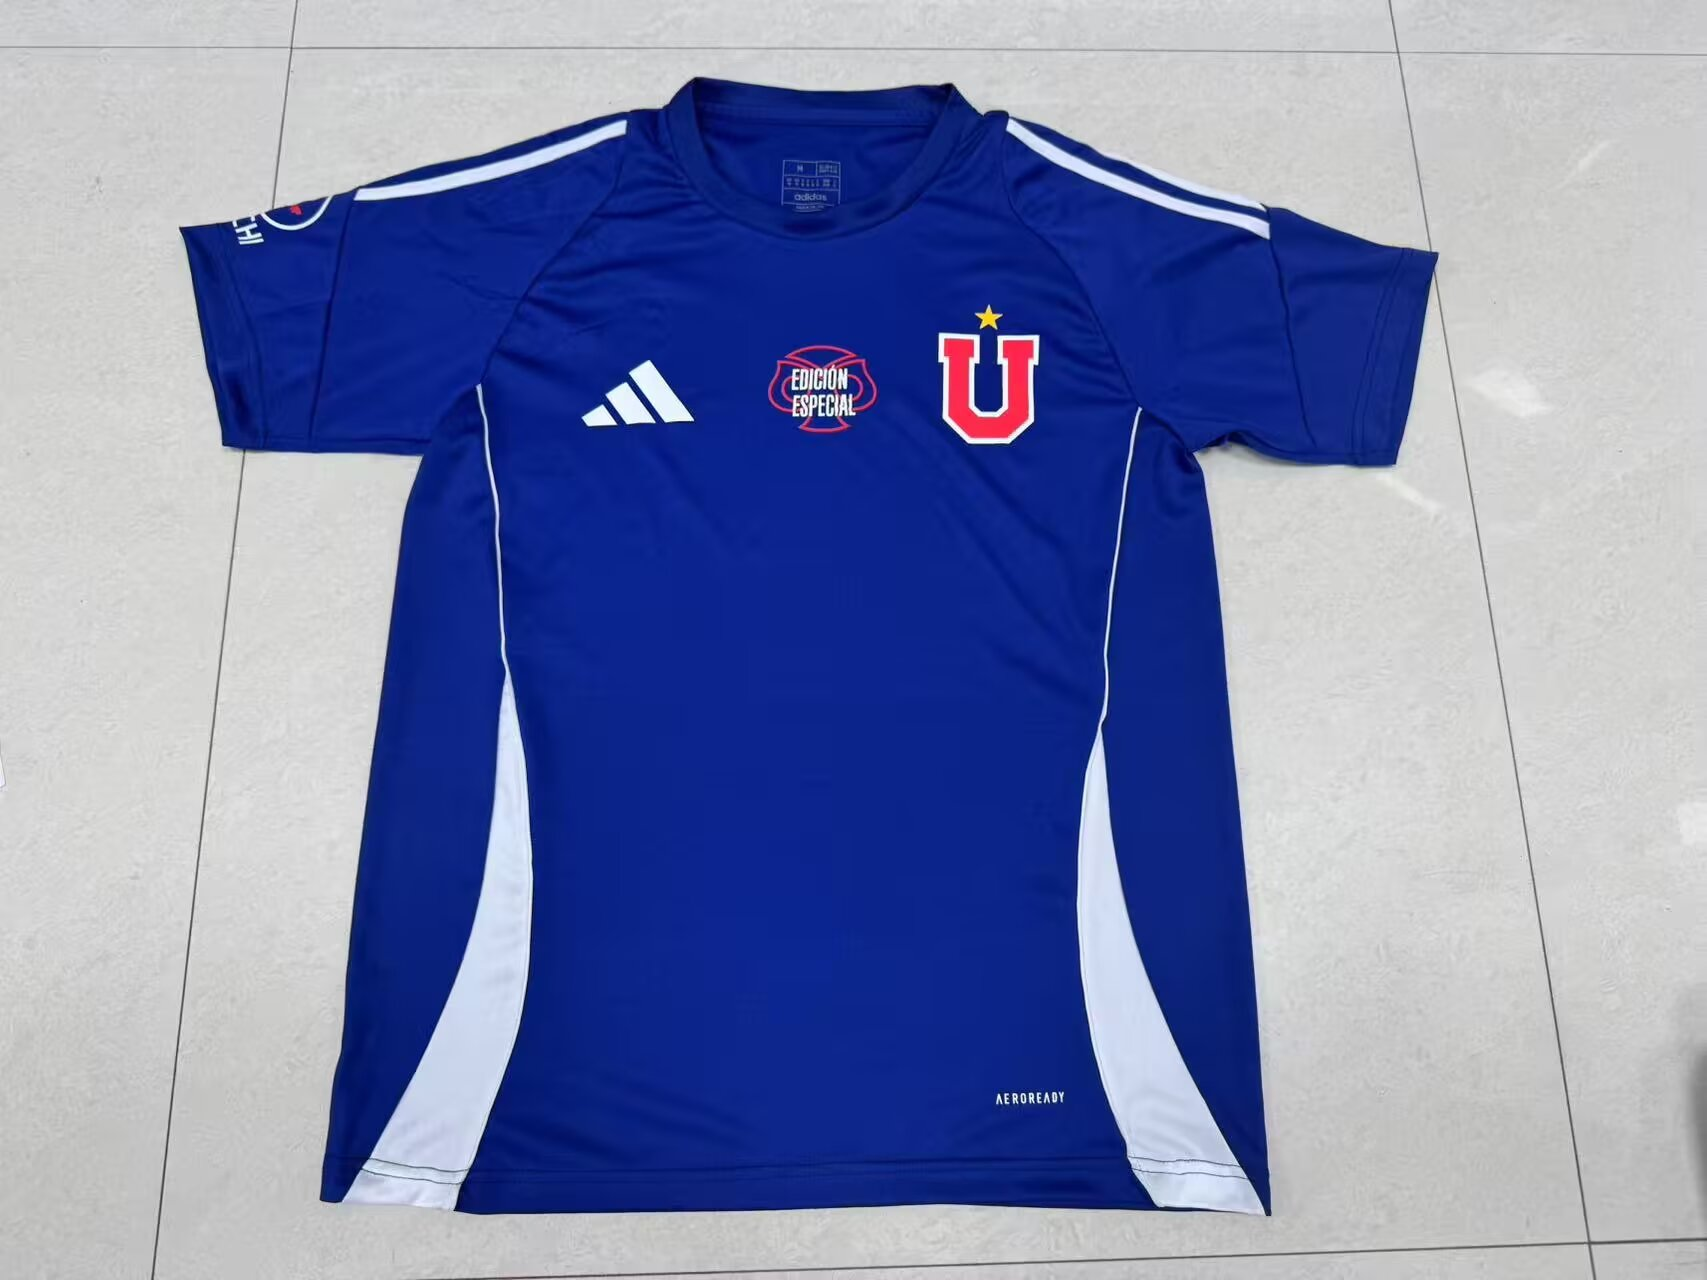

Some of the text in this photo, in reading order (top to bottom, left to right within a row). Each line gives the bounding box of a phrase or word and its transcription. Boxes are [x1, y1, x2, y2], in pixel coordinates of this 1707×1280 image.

[794, 193, 828, 202] adidas
[791, 364, 848, 391] EDICIÓN
[938, 332, 1040, 445] U
[792, 394, 857, 417] ESPECIAL
[995, 1091, 1065, 1105] AEROREADY
